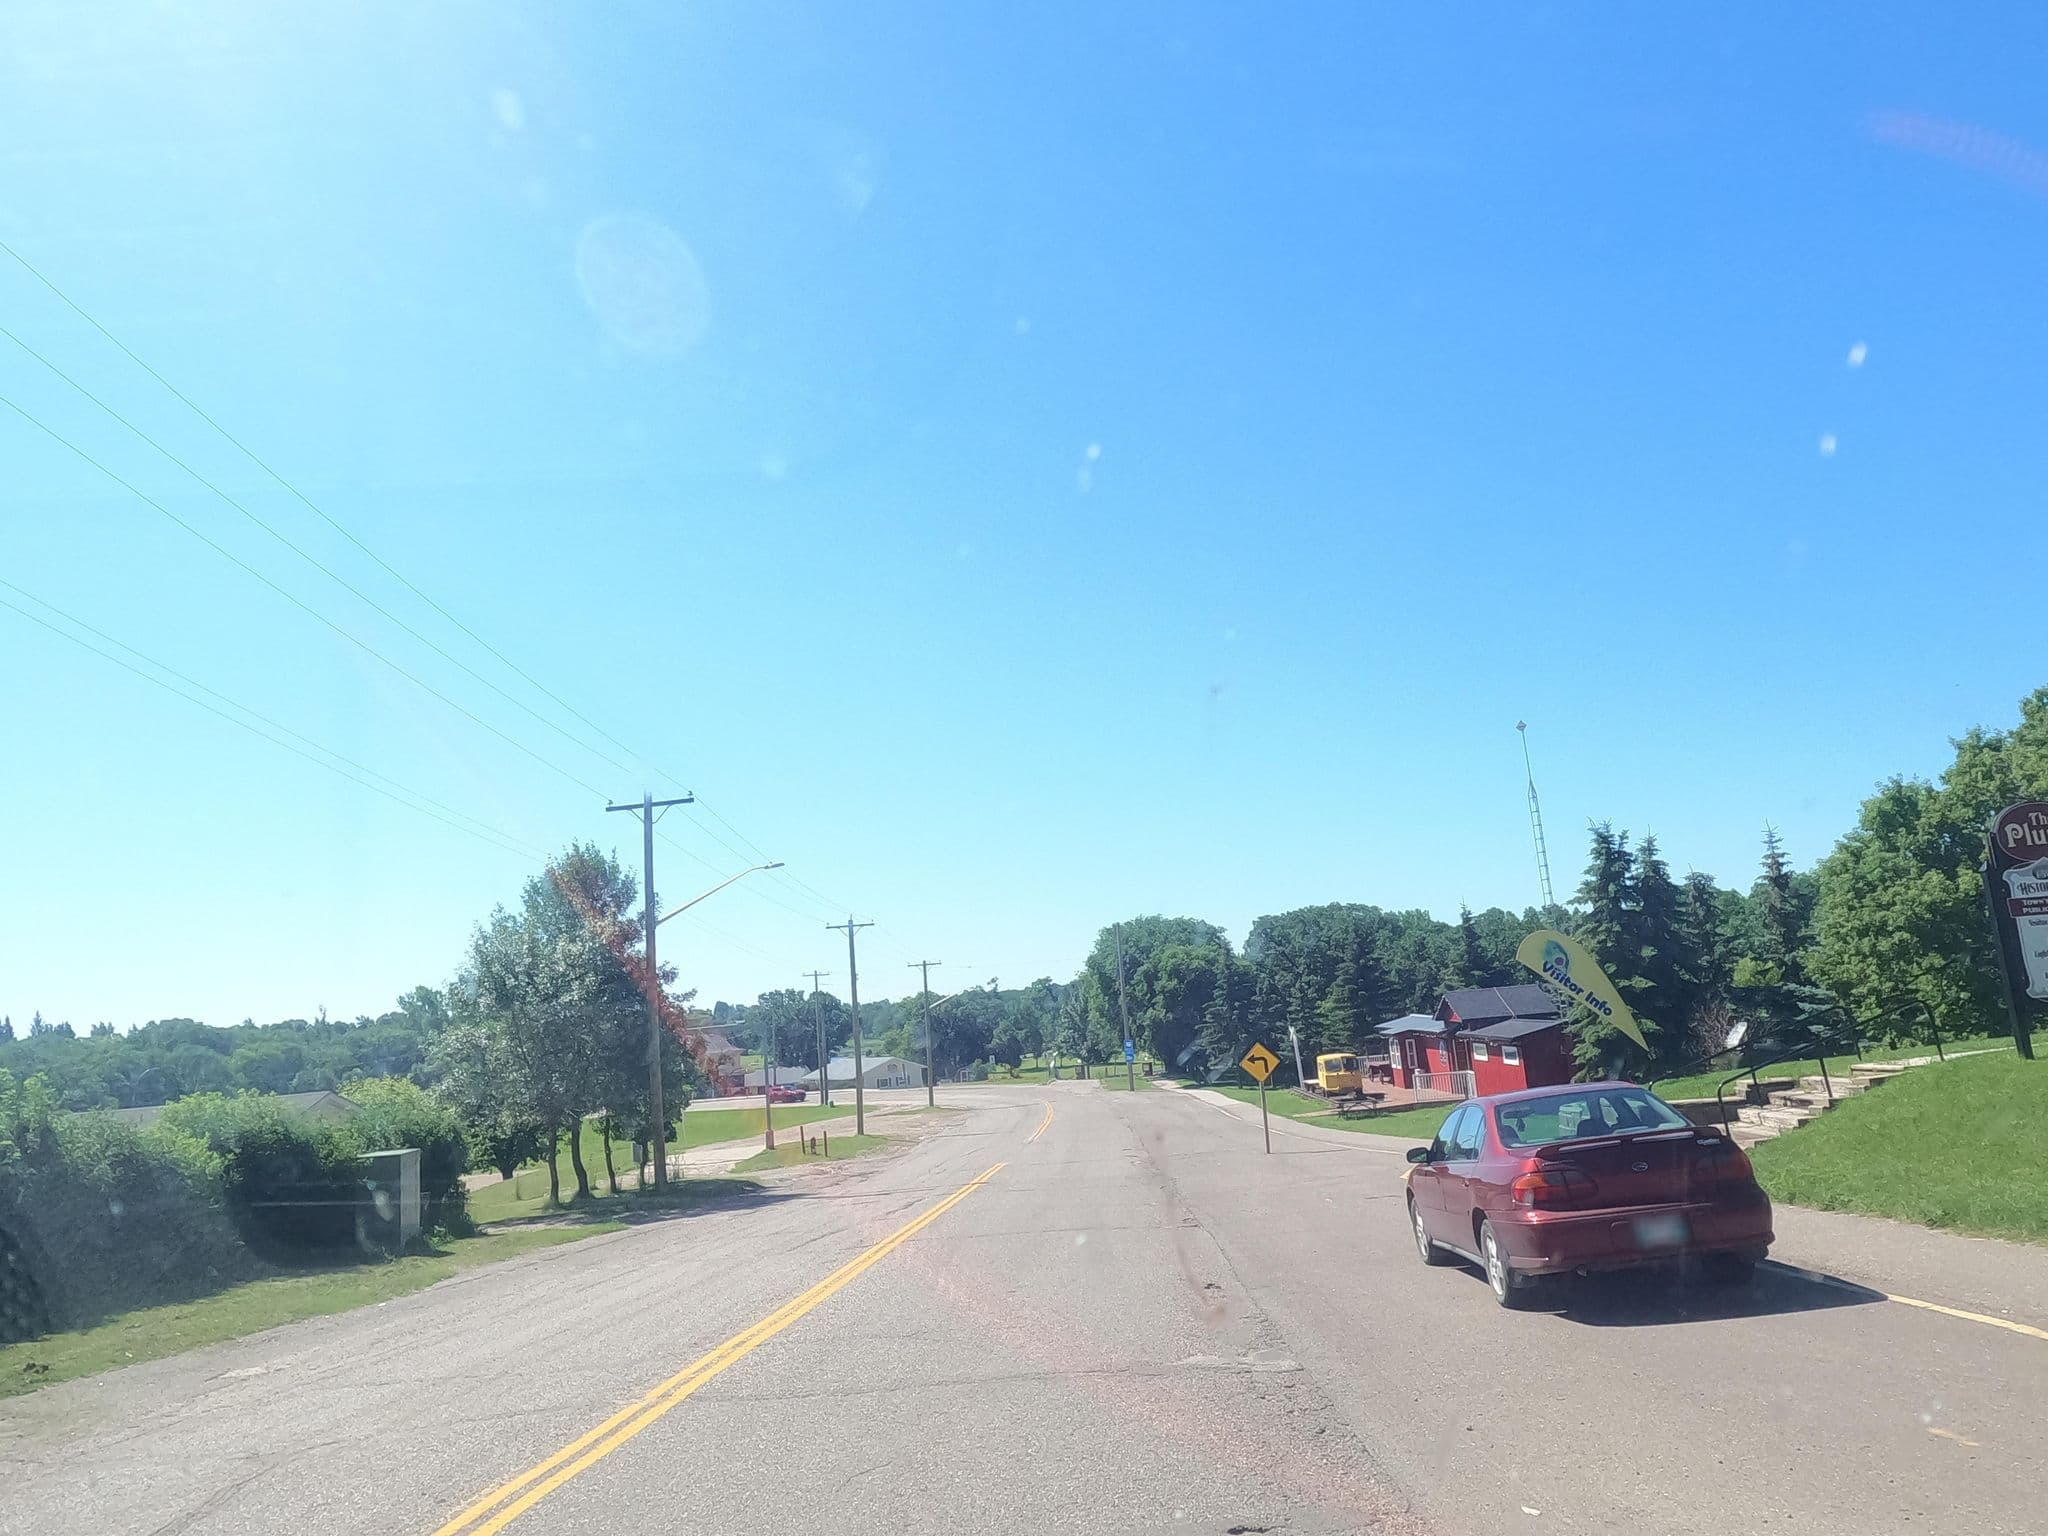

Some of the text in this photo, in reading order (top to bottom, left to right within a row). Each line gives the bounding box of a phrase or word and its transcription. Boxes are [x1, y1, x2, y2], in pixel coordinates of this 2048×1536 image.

[2028, 811, 2048, 826] Th
[2004, 822, 2048, 848] Plu
[1542, 960, 1612, 1016] Visitor Info
